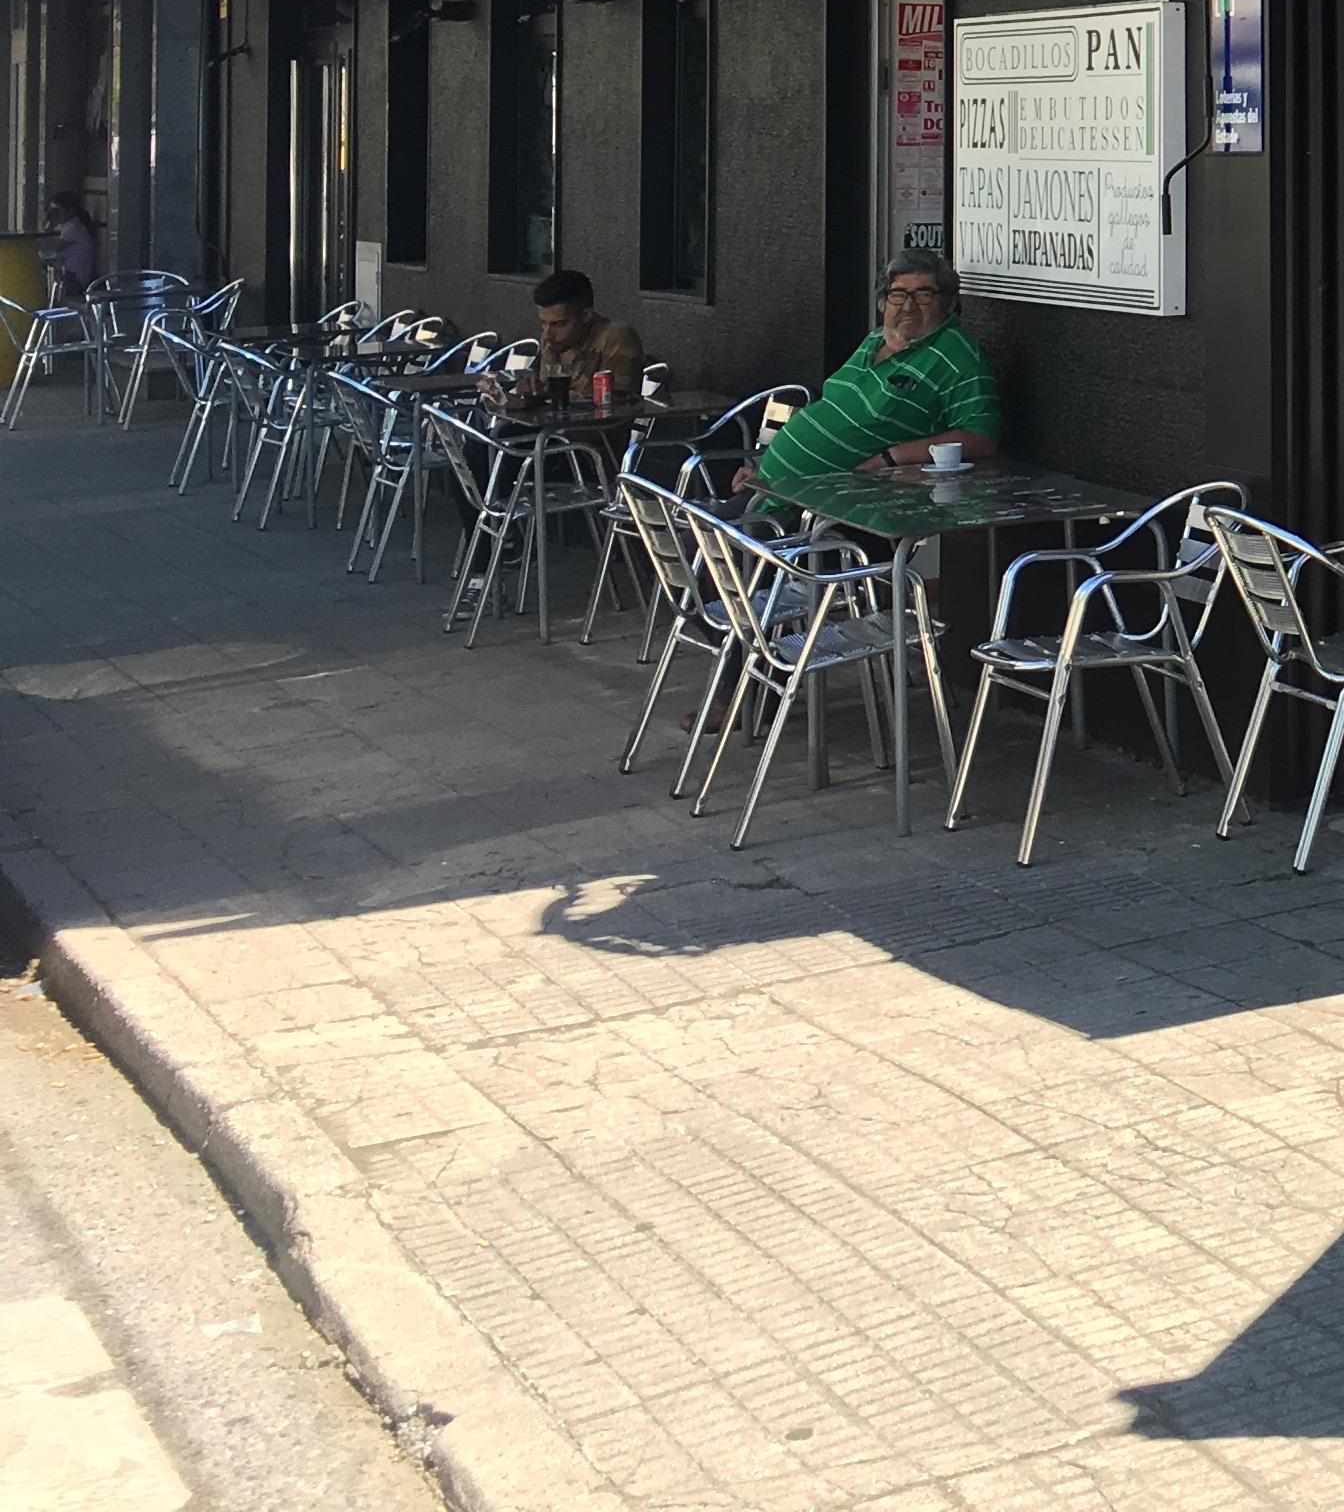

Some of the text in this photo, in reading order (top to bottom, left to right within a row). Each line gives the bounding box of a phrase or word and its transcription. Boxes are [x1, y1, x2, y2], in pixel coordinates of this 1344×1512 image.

[965, 42, 1072, 72] BOCADILLOS
[1085, 26, 1143, 71] PAN
[959, 97, 1006, 150] PIZZAS
[1019, 95, 1145, 121] EMBUTIDOS
[1019, 125, 1145, 152] DELICATESSEN
[959, 166, 1004, 209] TAPAS
[1013, 168, 1095, 223] JAMONES
[959, 220, 1004, 266] VINOS
[1012, 229, 1095, 272] EMPANADAS
